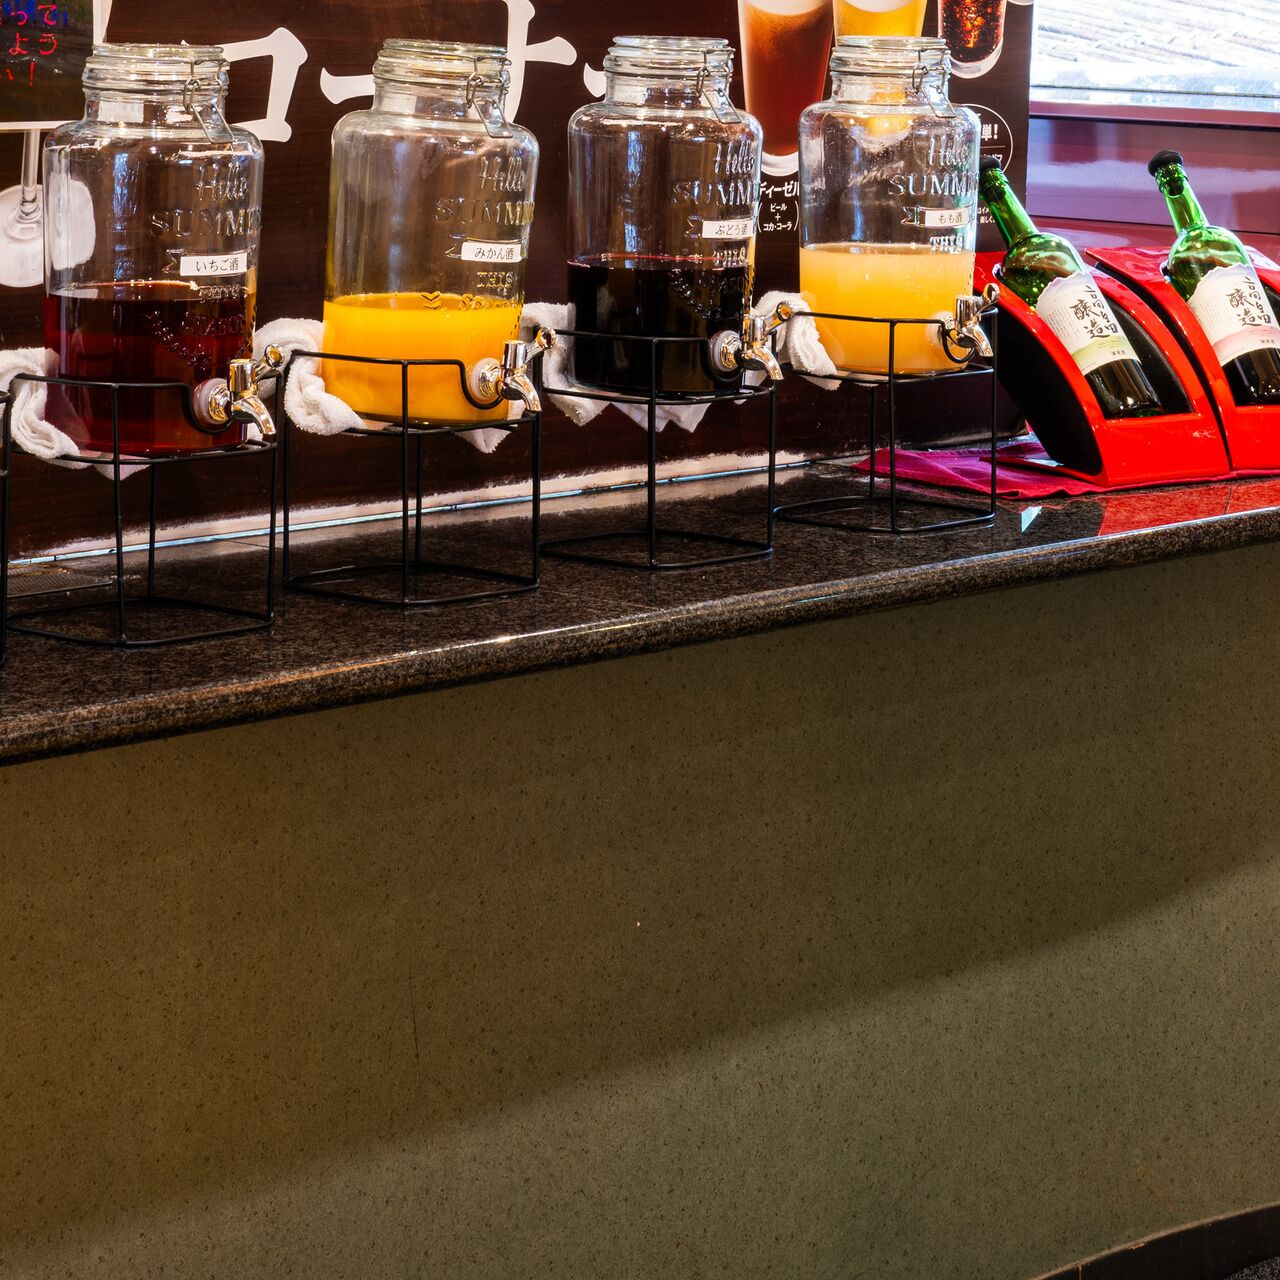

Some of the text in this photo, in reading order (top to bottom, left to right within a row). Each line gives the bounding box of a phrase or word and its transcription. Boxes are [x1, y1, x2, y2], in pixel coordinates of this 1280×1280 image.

[938, 210, 963, 225] もも酒
[474, 245, 516, 262] みかん酒
[195, 255, 240, 273] いちご酒
